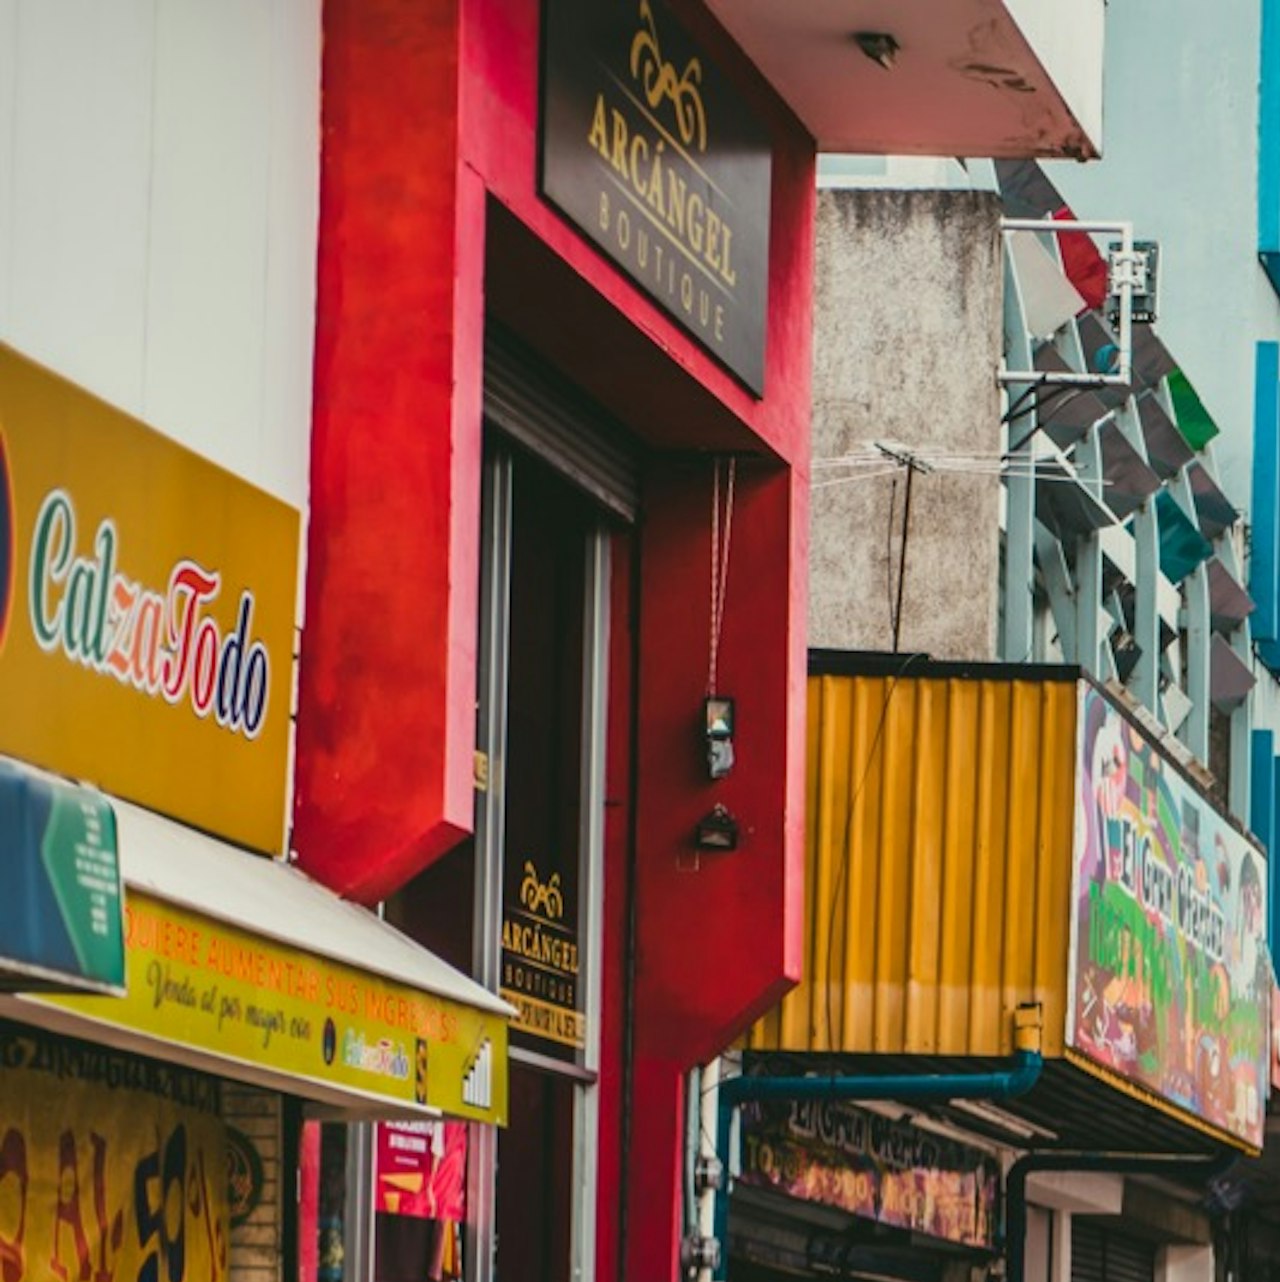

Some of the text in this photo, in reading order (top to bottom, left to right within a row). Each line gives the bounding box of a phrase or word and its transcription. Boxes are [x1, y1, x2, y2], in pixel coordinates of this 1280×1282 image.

[588, 93, 736, 287] ARCÁNGEL
[599, 191, 724, 342] BOUTIQUE
[30, 489, 269, 739] CalzaTodo
[206, 937, 320, 1003] AUMENTAR
[326, 976, 360, 1014] SUS
[501, 917, 578, 974] ARCÁNGEL
[505, 962, 573, 1005] BOUTIQUE
